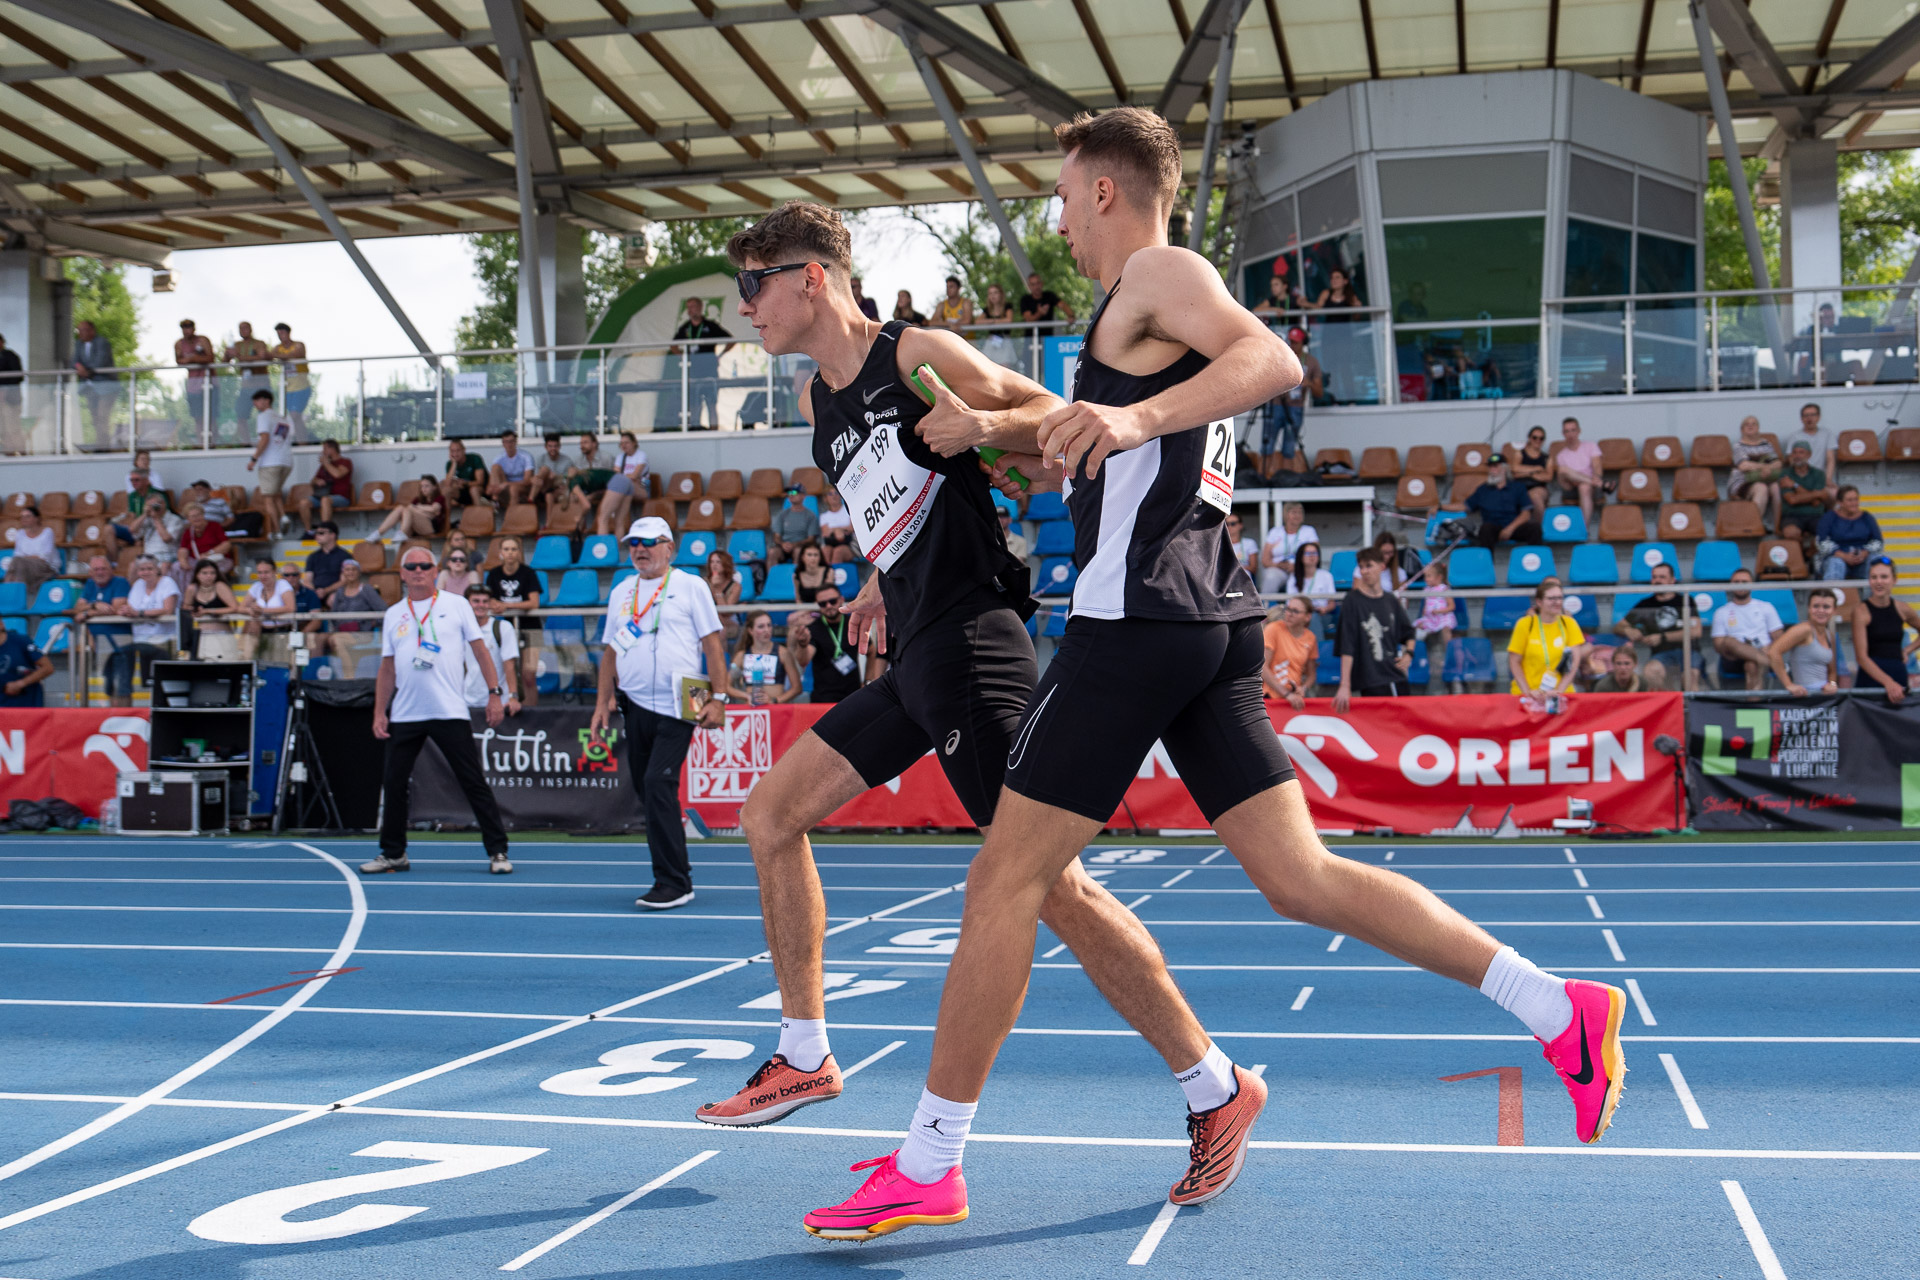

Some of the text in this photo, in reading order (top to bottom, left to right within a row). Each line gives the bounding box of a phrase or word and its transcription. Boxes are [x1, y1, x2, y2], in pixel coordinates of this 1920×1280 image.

[875, 408, 899, 420] OPOLE
[870, 428, 890, 463] 199
[864, 475, 909, 533] BRYLL
[874, 541, 885, 555] PZLA
[882, 513, 913, 547] MISTRZOSTWA
[910, 491, 929, 516] POLSKI
[889, 509, 927, 556] LUBLIN 2024
[1398, 728, 1646, 787] ORLEN
[1771, 748, 1839, 763] SPORTOWEGO
[1772, 735, 1839, 749] SZKOLENIA
[540, 777, 619, 790] INSPIRACJI
[1771, 763, 1839, 778] W LUBLINIE
[539, 1039, 756, 1098] 3
[750, 1074, 834, 1107] new balance
[186, 1140, 549, 1245] 2
